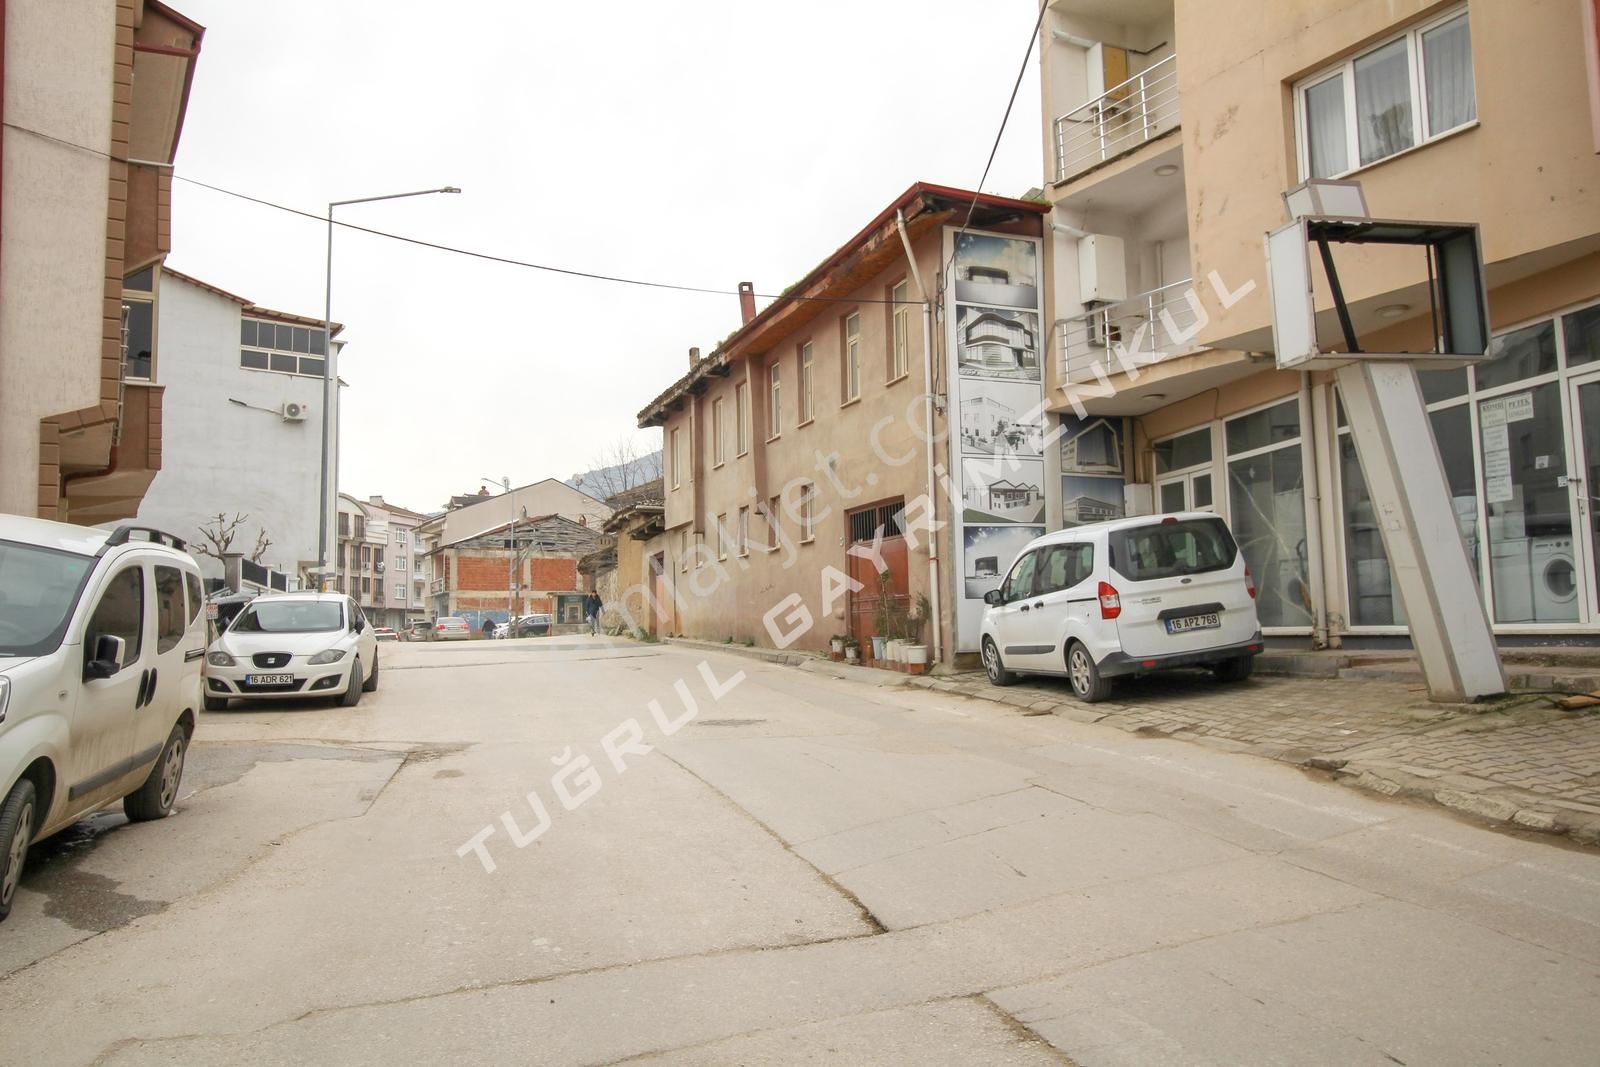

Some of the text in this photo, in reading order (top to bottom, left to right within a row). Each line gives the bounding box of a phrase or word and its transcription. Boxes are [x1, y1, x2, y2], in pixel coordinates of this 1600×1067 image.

[1172, 615, 1218, 629] 16 APZ 768
[261, 675, 278, 683] ADR
[280, 675, 292, 683] 621
